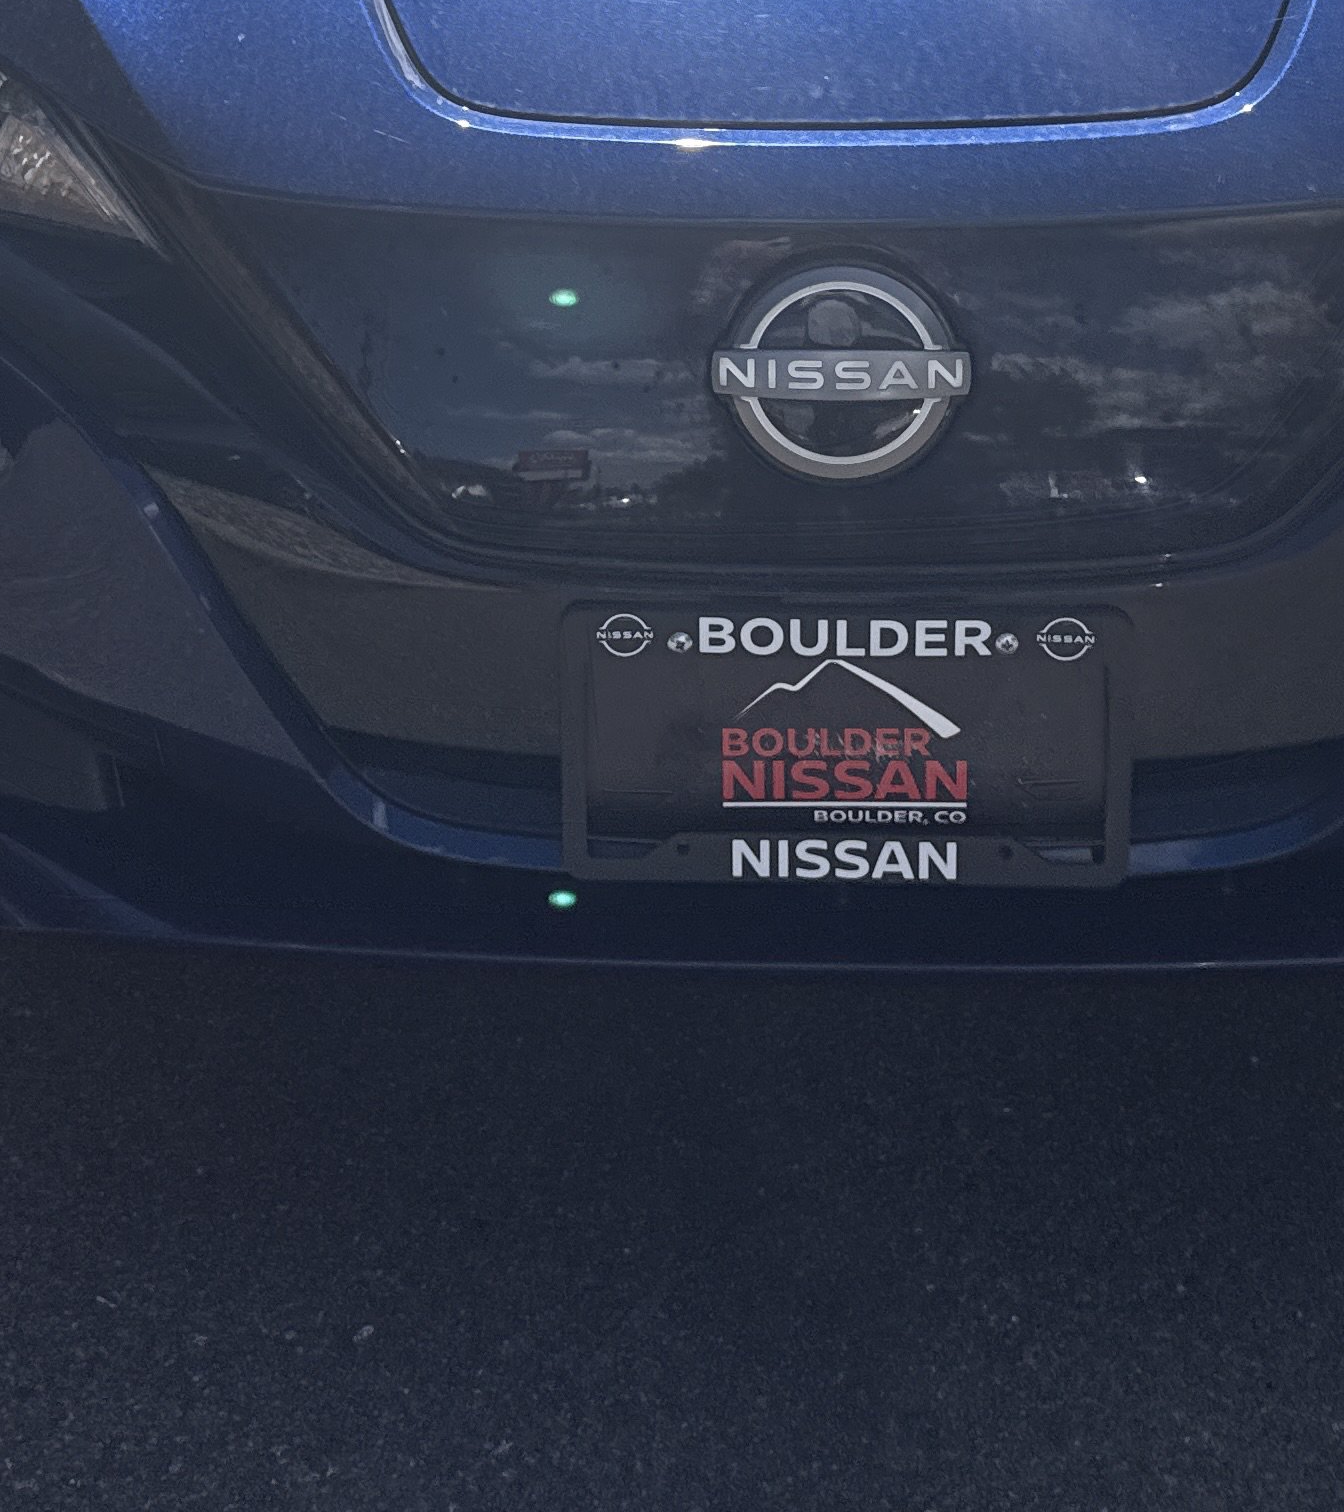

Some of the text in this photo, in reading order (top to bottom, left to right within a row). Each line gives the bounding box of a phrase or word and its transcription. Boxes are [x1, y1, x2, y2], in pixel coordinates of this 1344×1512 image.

[718, 357, 963, 390] NISSAN
[596, 630, 654, 639] NISSAN
[698, 617, 992, 657] BOULDER
[1036, 634, 1096, 643] NISSAN
[721, 727, 930, 757] BOULDER
[721, 760, 968, 800] NISSAN
[813, 809, 967, 825] BOULDER, CO
[731, 838, 957, 880] NISSAN
